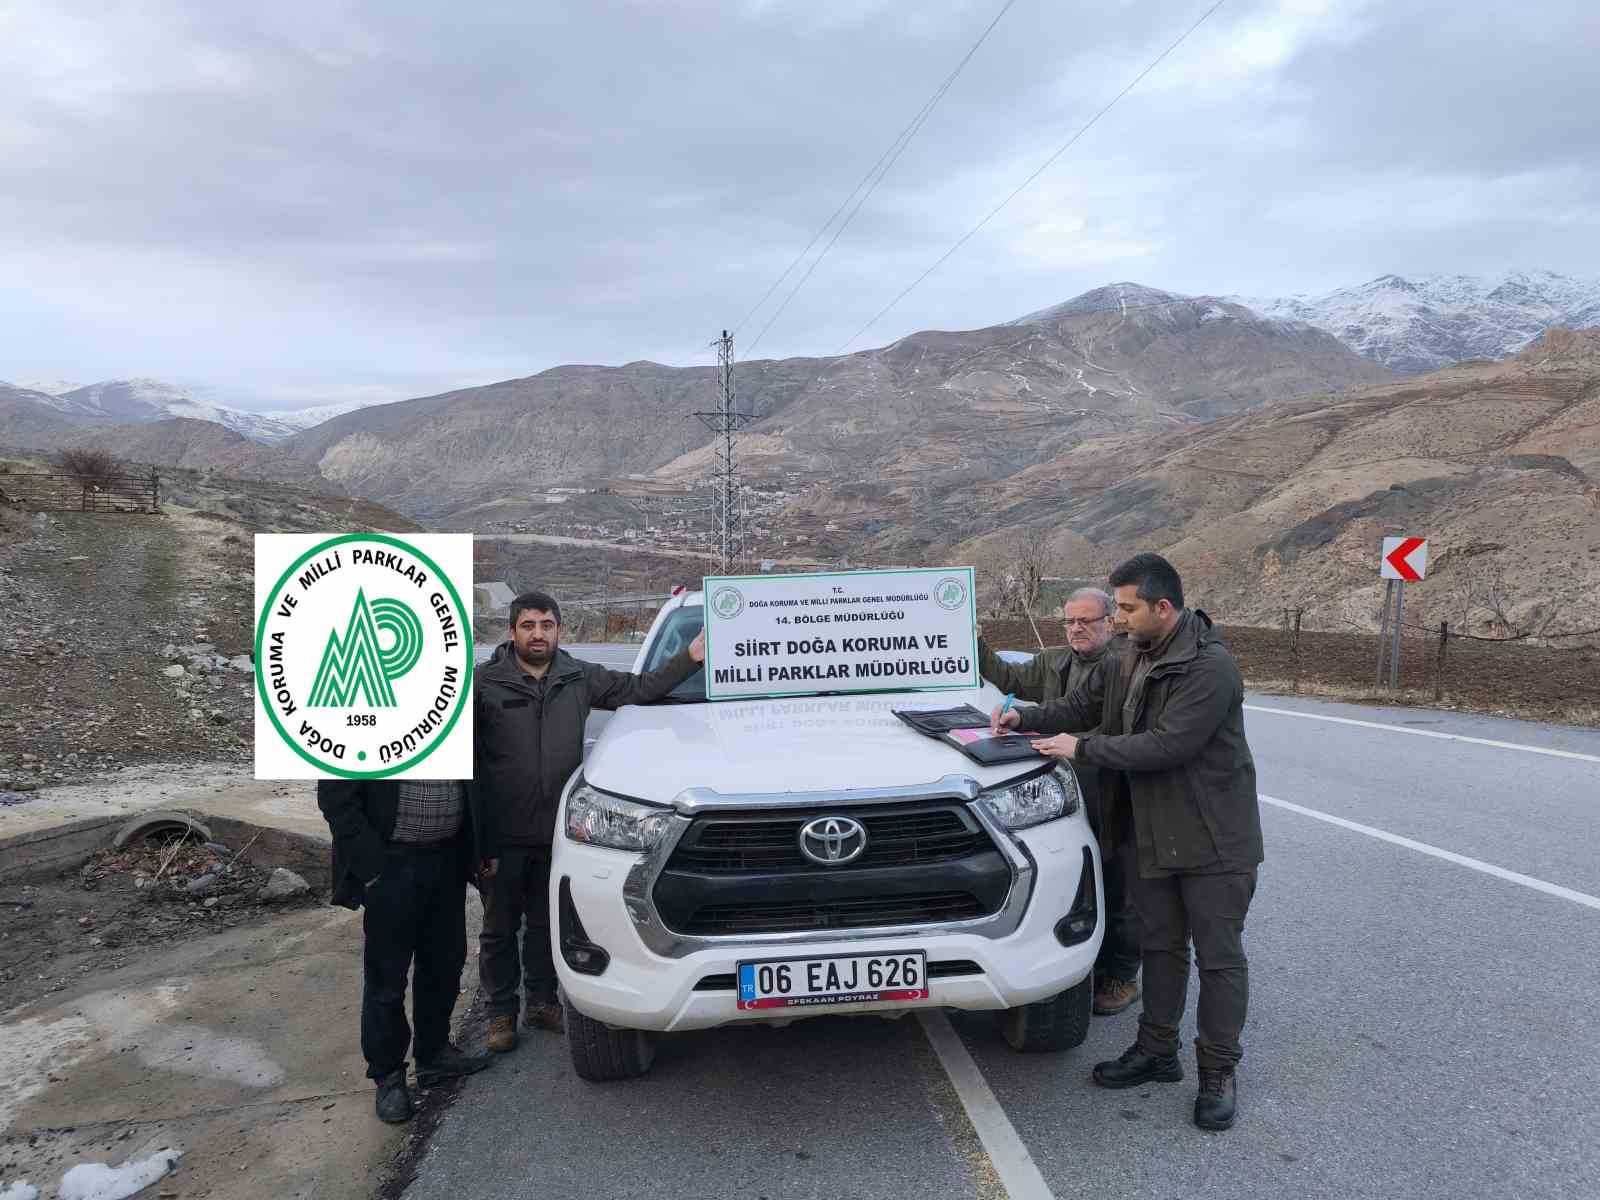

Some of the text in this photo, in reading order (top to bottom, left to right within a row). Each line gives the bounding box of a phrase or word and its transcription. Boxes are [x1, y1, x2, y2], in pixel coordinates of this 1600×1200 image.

[769, 599, 799, 608] KORUMA
[801, 598, 809, 606] VE
[830, 596, 861, 605] PARKLAR
[862, 595, 885, 604] GENEL
[775, 616, 792, 625] 14.
[834, 611, 905, 622] MÜDÜRLÜĞÜ
[734, 634, 948, 657] SİİRT DOĞA KORUMA VE
[715, 656, 970, 684] MİLLİ PARKLAR MÜDÜRLÜĞÜ
[759, 957, 918, 994] 06 EAJ 626
[742, 984, 754, 993] TR
